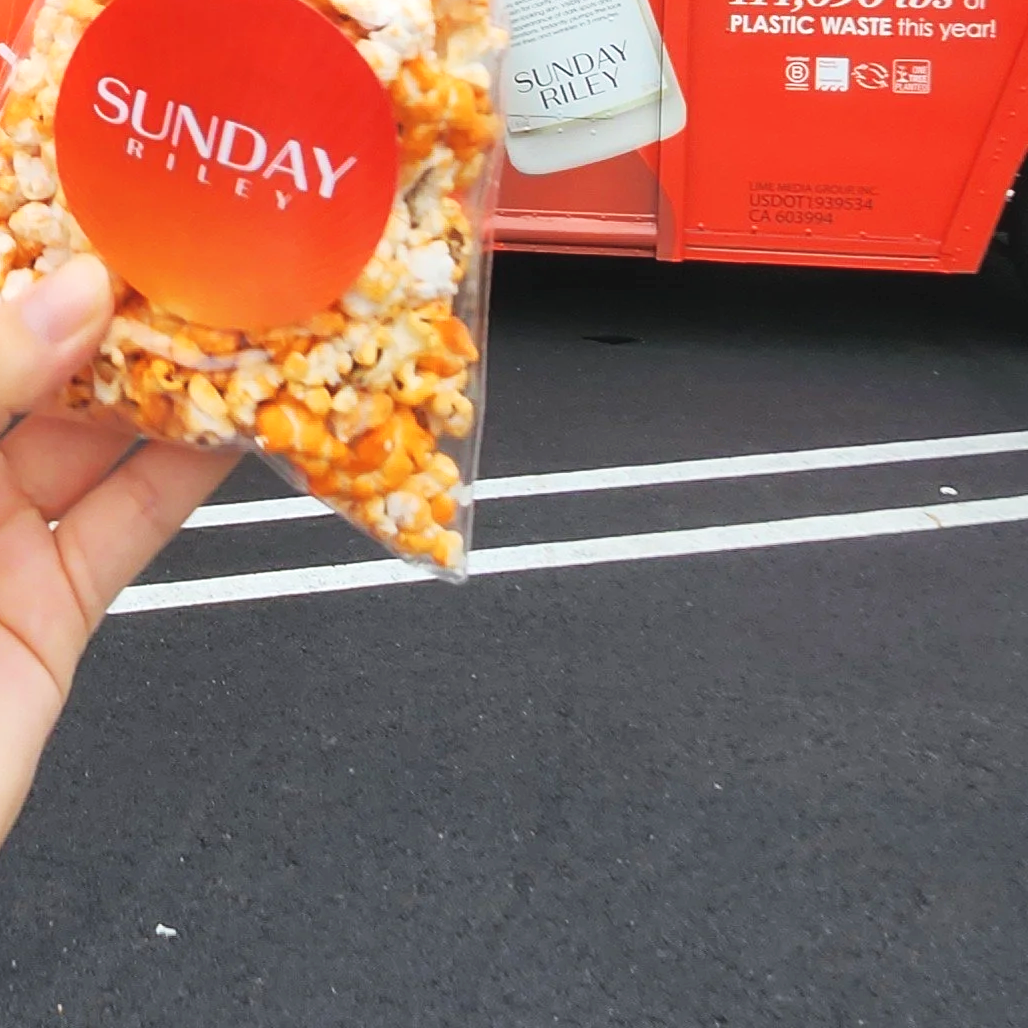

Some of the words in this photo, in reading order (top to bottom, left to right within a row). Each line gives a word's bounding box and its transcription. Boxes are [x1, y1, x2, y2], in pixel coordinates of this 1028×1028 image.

[730, 15, 814, 35] PLASTIC
[820, 17, 893, 36] WASTE
[898, 17, 933, 37] this
[939, 19, 997, 42] year!
[513, 40, 627, 93] SUNDAY
[539, 67, 619, 110] RILEY
[93, 76, 358, 199] SUNDAY
[126, 137, 293, 210] RILEY
